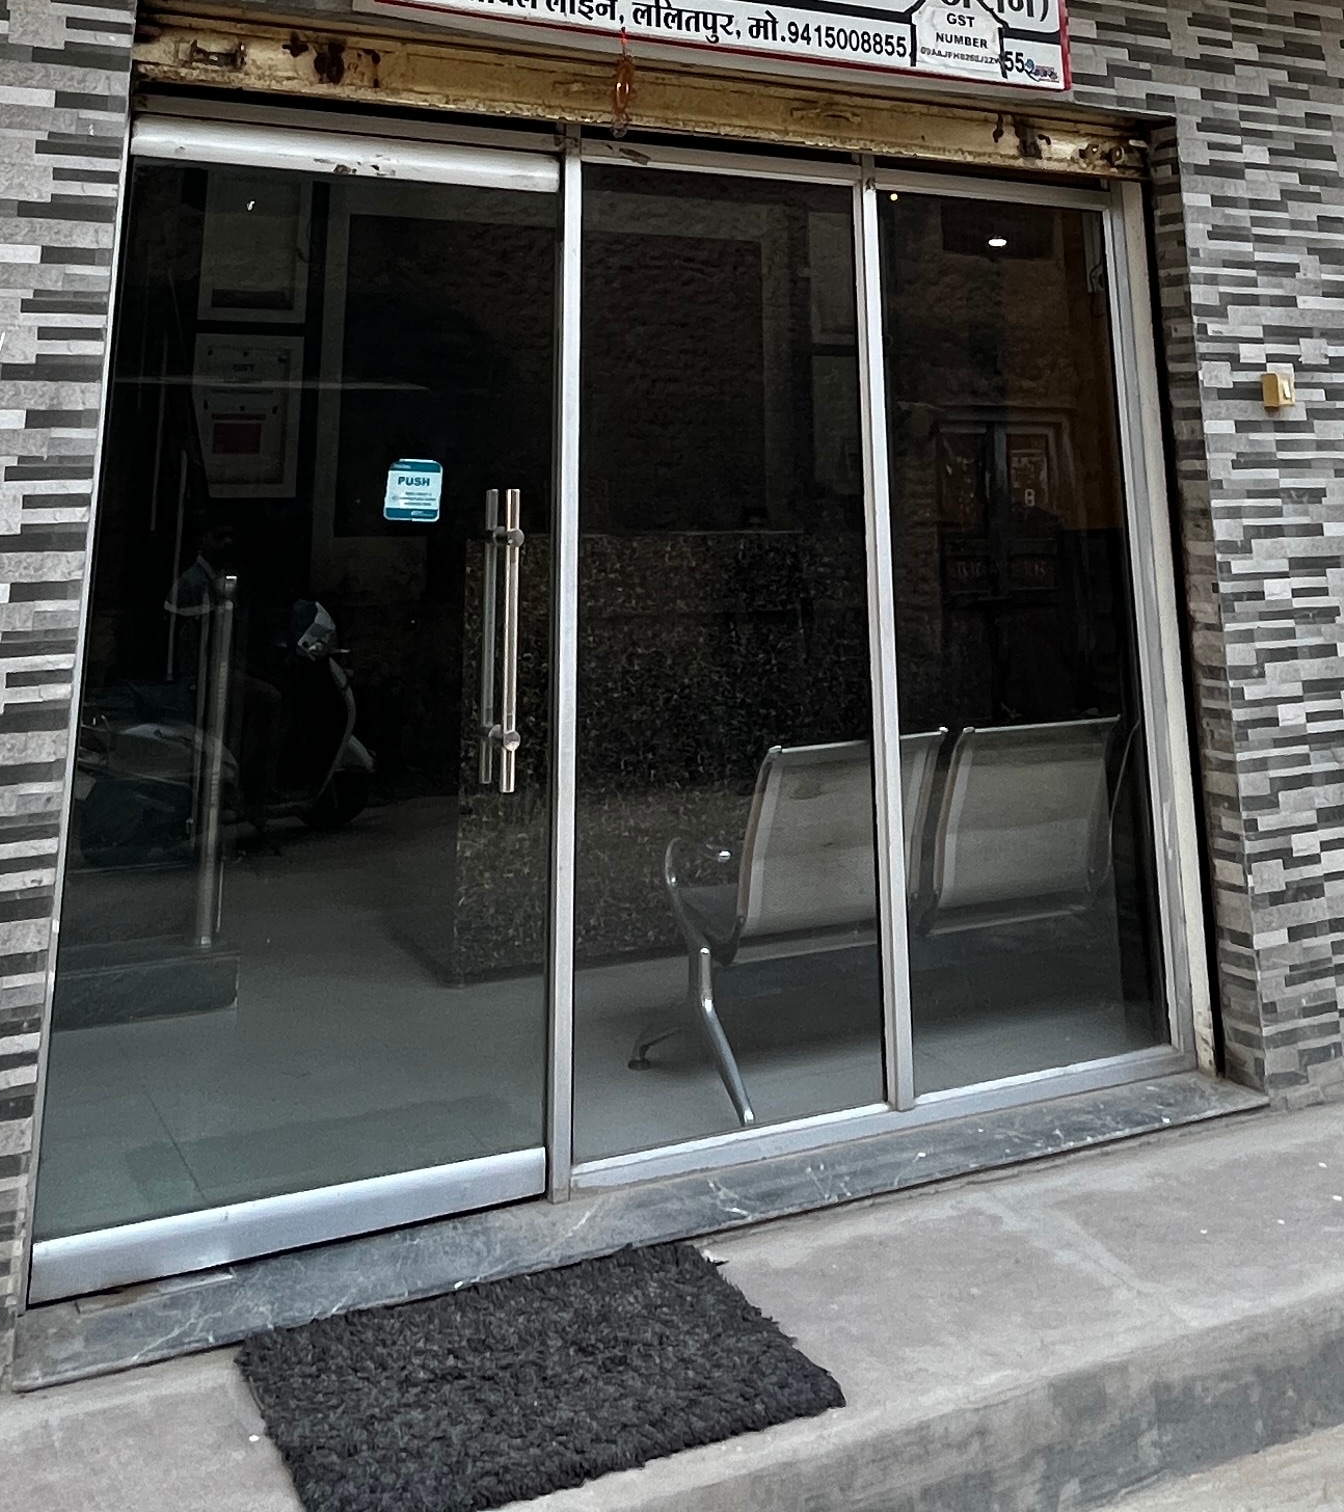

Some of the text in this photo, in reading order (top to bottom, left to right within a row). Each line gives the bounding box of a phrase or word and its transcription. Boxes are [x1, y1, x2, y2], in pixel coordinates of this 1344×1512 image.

[946, 12, 975, 28] GST
[935, 31, 989, 50] NUMBER
[397, 476, 431, 487] PUSH
